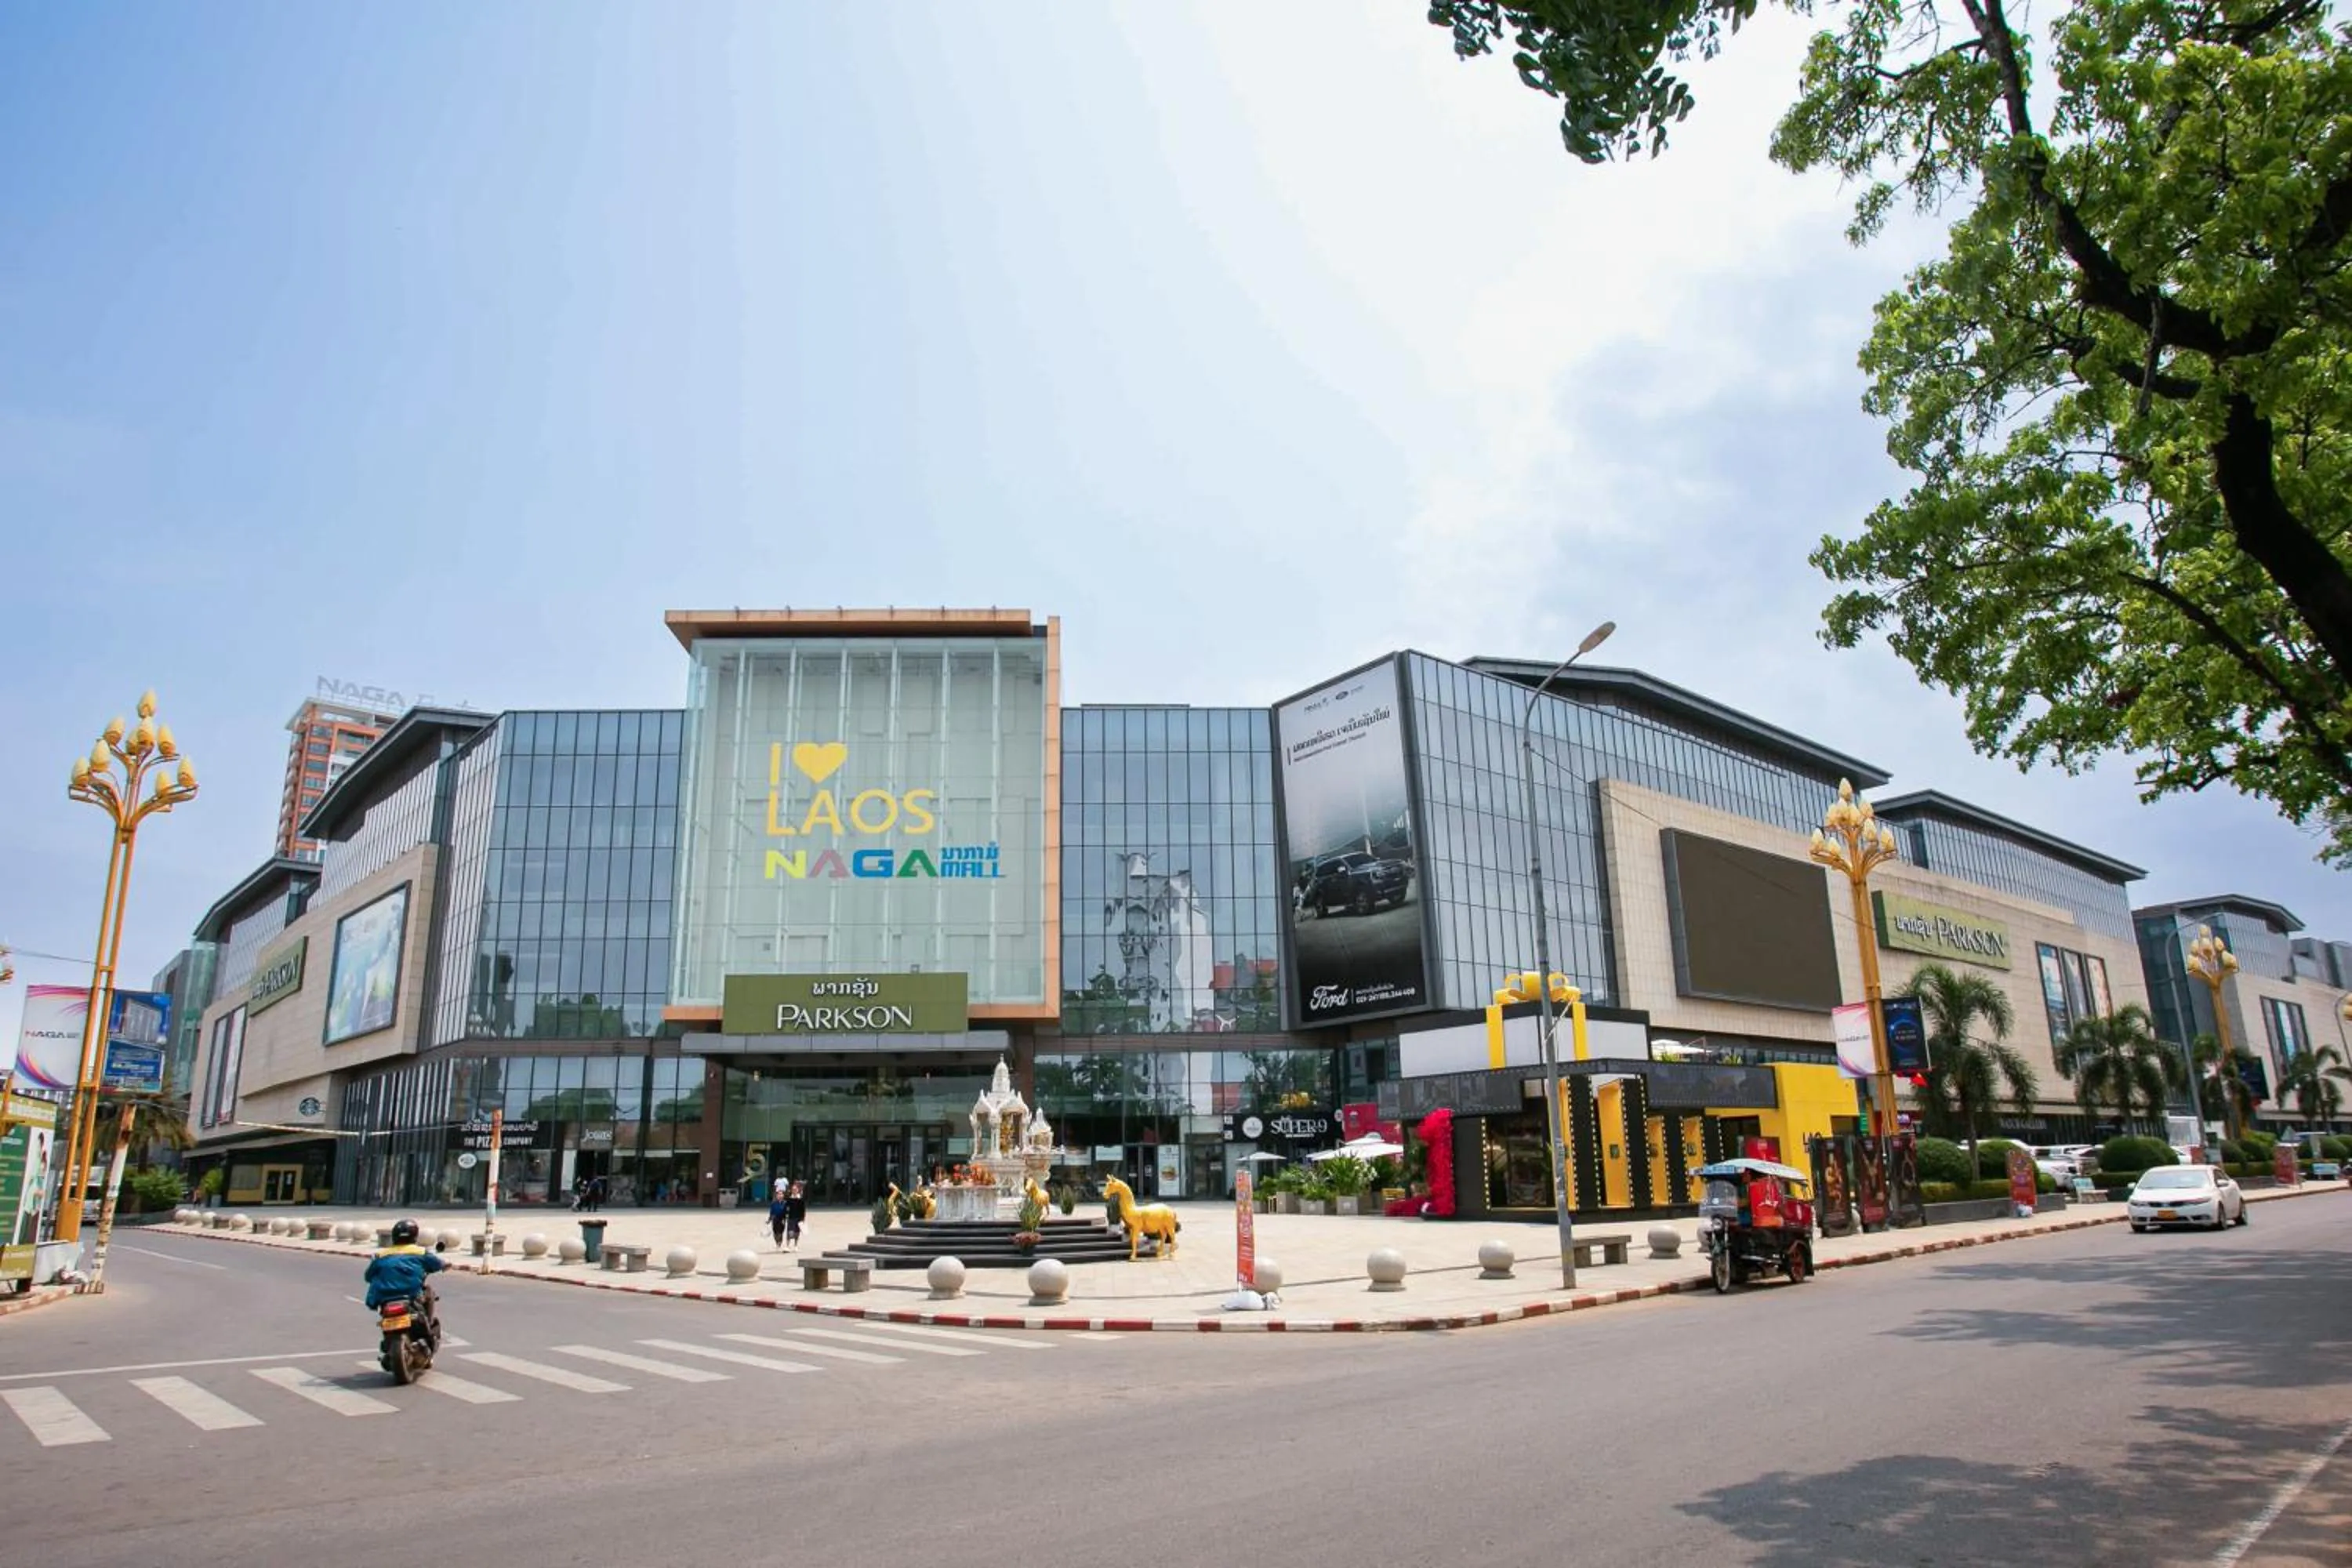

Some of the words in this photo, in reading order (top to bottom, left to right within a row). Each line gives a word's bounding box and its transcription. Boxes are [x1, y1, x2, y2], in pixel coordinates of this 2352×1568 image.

[318, 675, 405, 706] NAGA
[769, 742, 782, 786] I
[766, 789, 935, 836] LAOS
[764, 849, 939, 879] NAGA
[941, 862, 1005, 878] MALL
[1935, 915, 2005, 958] PARKSON
[1310, 984, 1348, 1011] Ford
[776, 1004, 913, 1029] PARKSON
